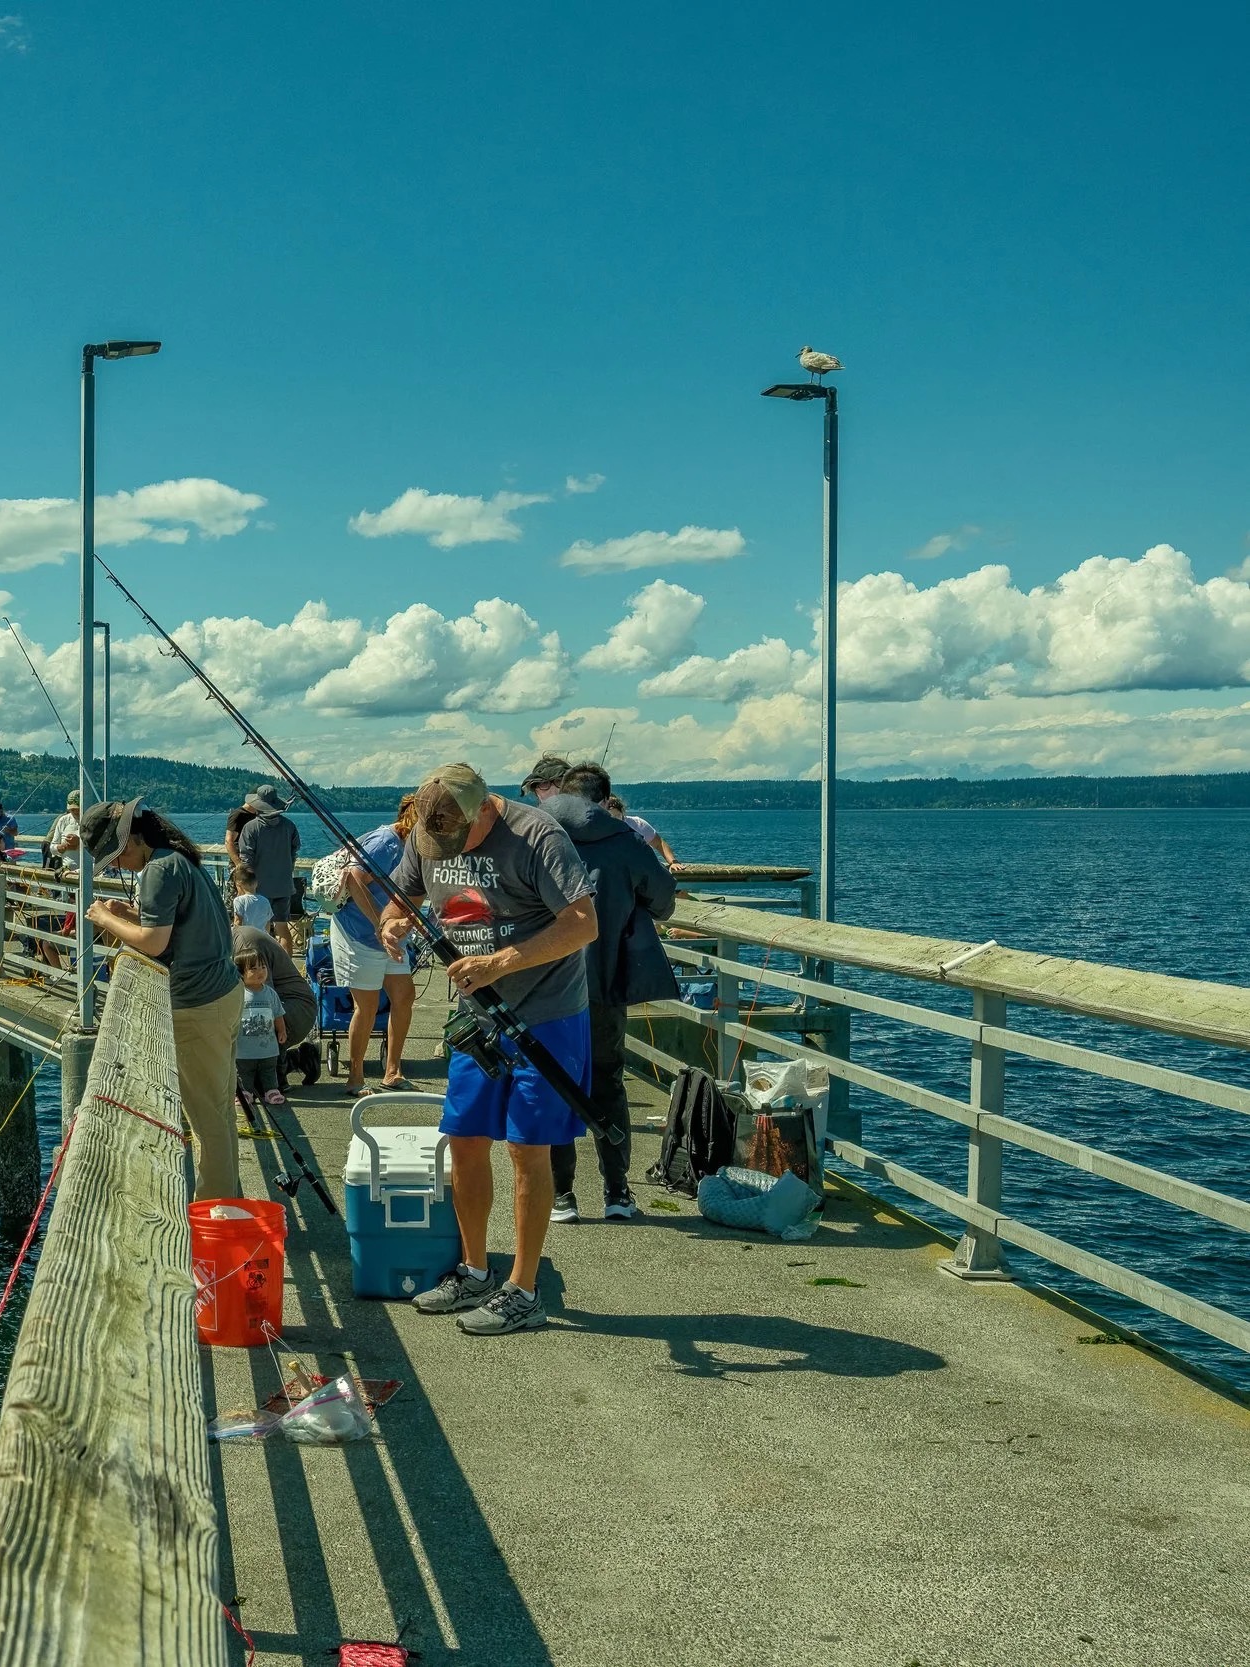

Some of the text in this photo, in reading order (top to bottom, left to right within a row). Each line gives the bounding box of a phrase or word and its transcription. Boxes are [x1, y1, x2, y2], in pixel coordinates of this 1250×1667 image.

[432, 867, 500, 888] FORECAST
[452, 927, 495, 942] CHANCE
[499, 924, 515, 937] OF
